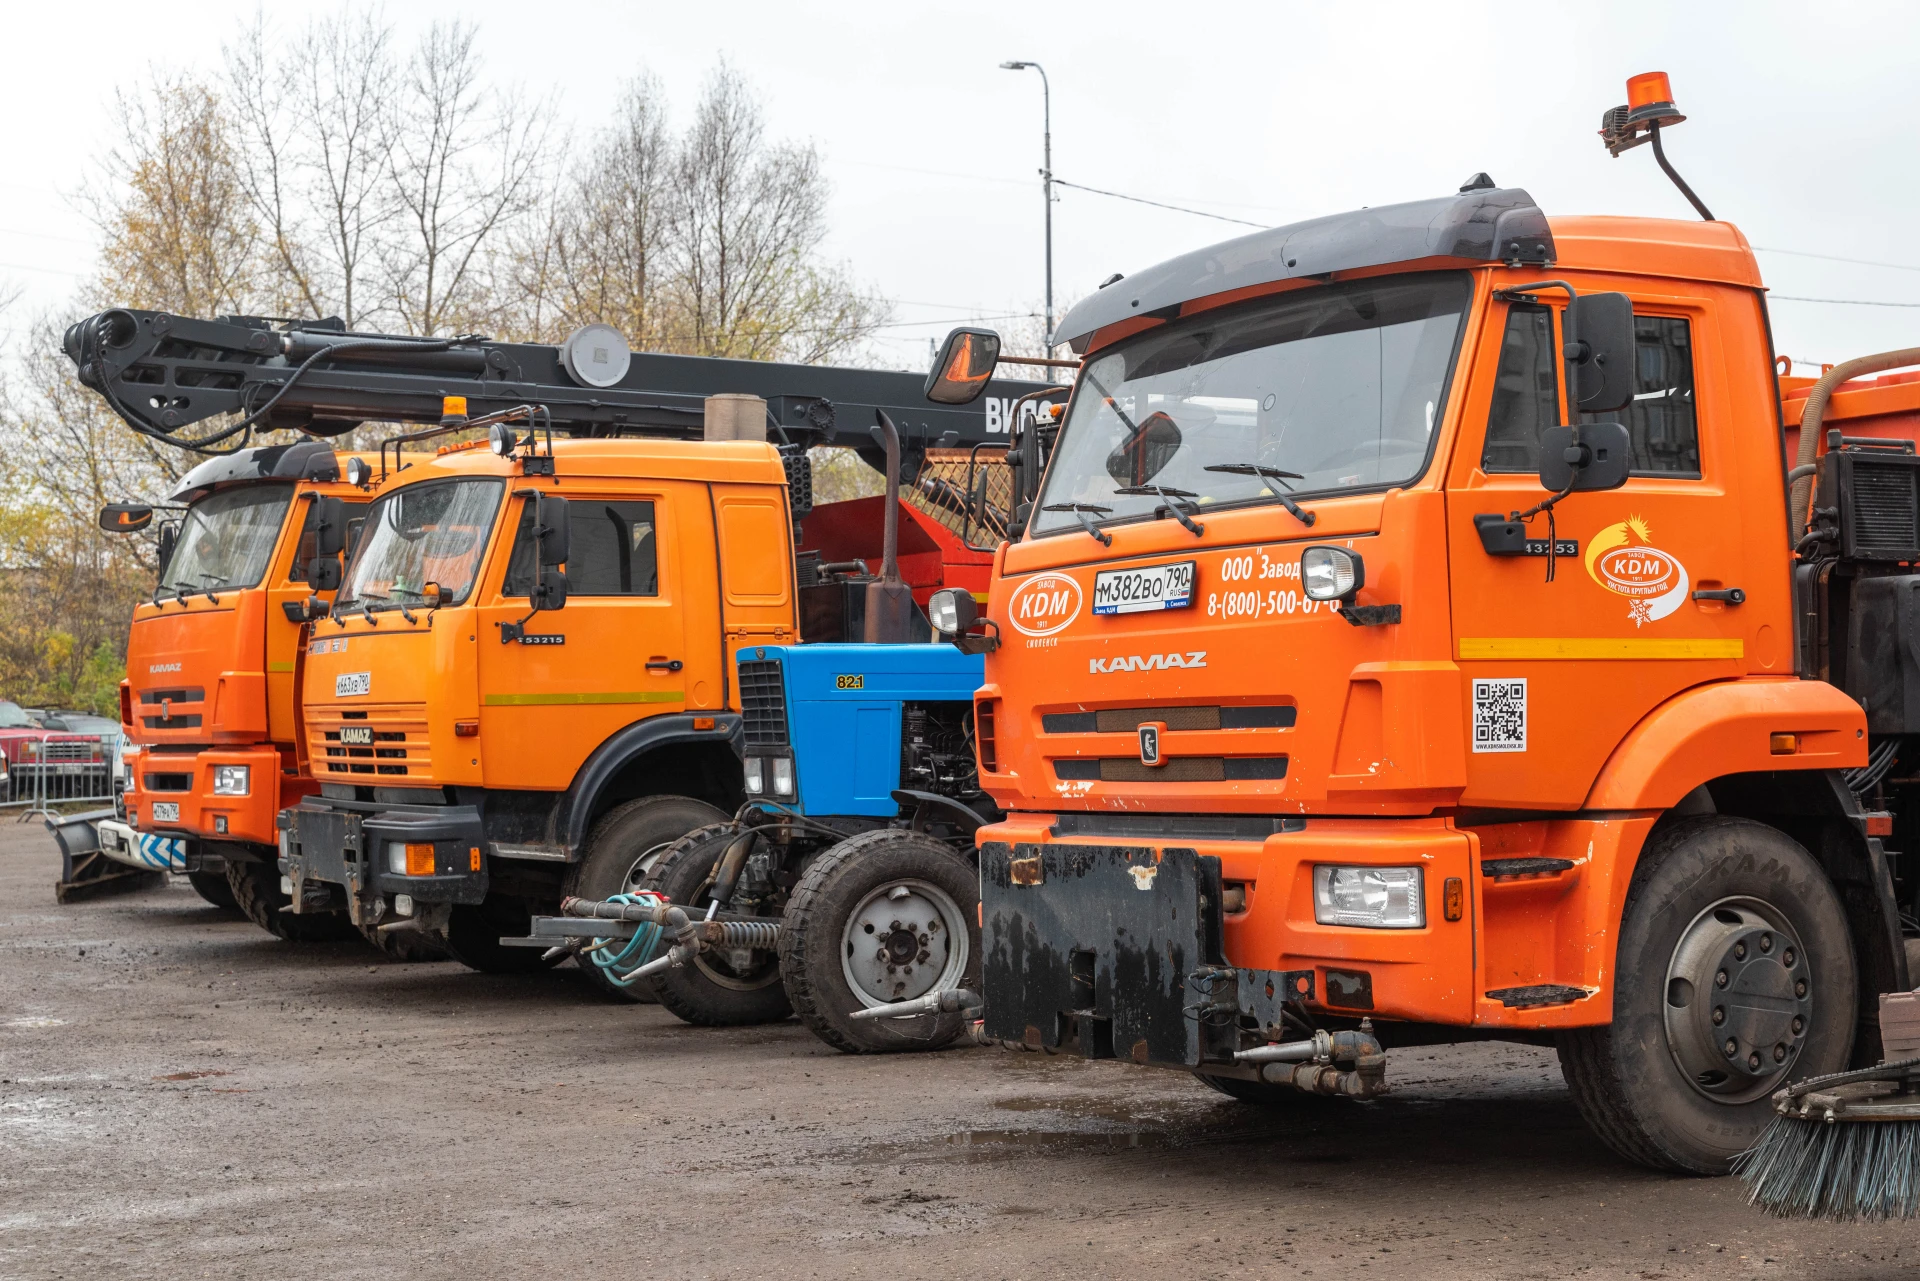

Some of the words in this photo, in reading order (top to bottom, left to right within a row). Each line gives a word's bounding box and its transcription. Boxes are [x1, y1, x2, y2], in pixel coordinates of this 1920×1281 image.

[1221, 556, 1253, 581] ООО
[1614, 559, 1660, 575] KDM
[1166, 566, 1189, 589] 790
[1169, 589, 1182, 597] RUS
[1020, 589, 1070, 619] KDM
[149, 662, 182, 674] KAMAZ
[1089, 651, 1207, 674] KAMAZ
[836, 674, 864, 690] 82.1
[340, 728, 371, 744] KAMAZ
